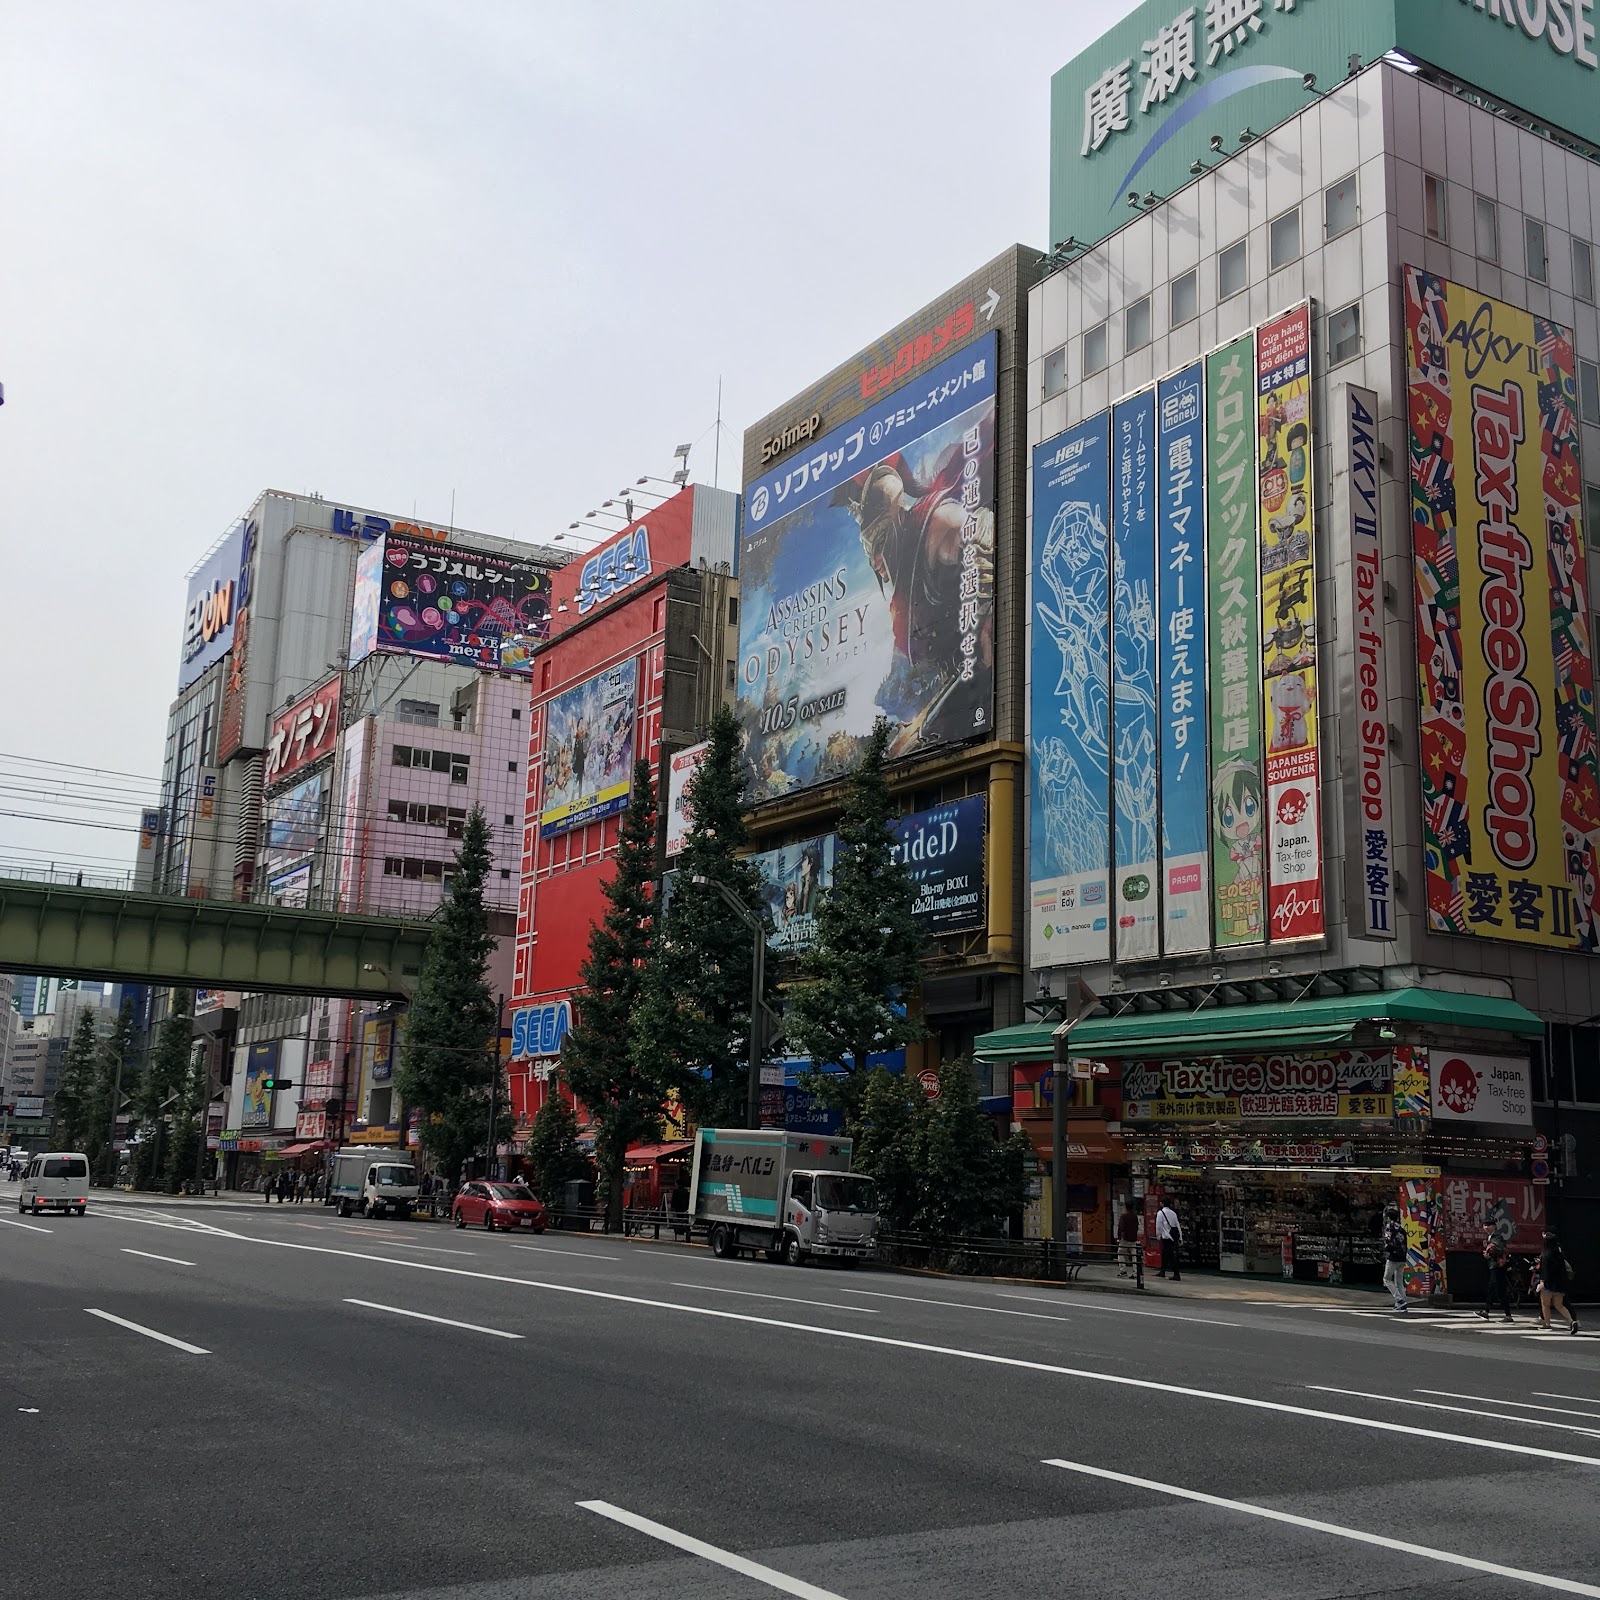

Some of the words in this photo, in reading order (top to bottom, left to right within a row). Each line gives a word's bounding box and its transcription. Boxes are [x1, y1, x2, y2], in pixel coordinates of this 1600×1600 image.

[1080, 0, 1298, 157] 廣瀬無
[1281, 320, 1303, 343] hàng
[1446, 301, 1522, 379] AKKY
[861, 301, 974, 399] ビックカメラ
[1261, 358, 1307, 391] 日本特産
[1164, 409, 1197, 429] money
[760, 412, 820, 465] Sofmap
[1055, 439, 1085, 465] Hey
[1351, 392, 1377, 518] AKKY
[774, 427, 865, 503] ソフマップ
[1135, 409, 1147, 522] ゲームセンターを
[1473, 382, 1532, 673] Tax-free
[386, 536, 420, 550] ADULT
[422, 544, 484, 562] AMUSEMENT
[485, 557, 512, 569] PARK
[408, 552, 516, 584] ラブメルシー
[960, 427, 981, 681] 己の運命を選択せよ
[1215, 353, 1250, 754] メロンブックス秋葉原店
[579, 525, 653, 614] SEGA
[783, 605, 828, 639] CREED
[1354, 548, 1382, 713] Tax-free
[744, 603, 870, 685] ODYSSEY
[761, 697, 798, 735] 10.5
[800, 702, 819, 721] ON
[819, 690, 845, 716] SALE
[267, 697, 333, 775] オノテン
[1267, 751, 1316, 772] JAPANESE
[1267, 763, 1316, 782] SOUVENIR
[1362, 719, 1386, 821] Shop
[1485, 677, 1540, 867] Shop
[1276, 848, 1312, 863] Tax-free
[1277, 834, 1310, 848] Japan.
[1171, 874, 1198, 886] PASMO
[1283, 862, 1306, 875] Shop
[920, 882, 946, 897] Blu-ray
[1061, 897, 1075, 908] Edy
[1217, 879, 1262, 900] このビル
[1272, 888, 1312, 932] AKKY
[511, 1000, 574, 1059] SEGA
[1164, 1063, 1262, 1090] Tax-free
[1269, 1059, 1333, 1088] Shop
[1487, 1083, 1525, 1099] Tax-free
[1490, 1066, 1524, 1083] Japan.
[1156, 1101, 1237, 1117] 海外向け電気製品
[1502, 1100, 1526, 1117] Shop
[1221, 1145, 1243, 1156] Shop
